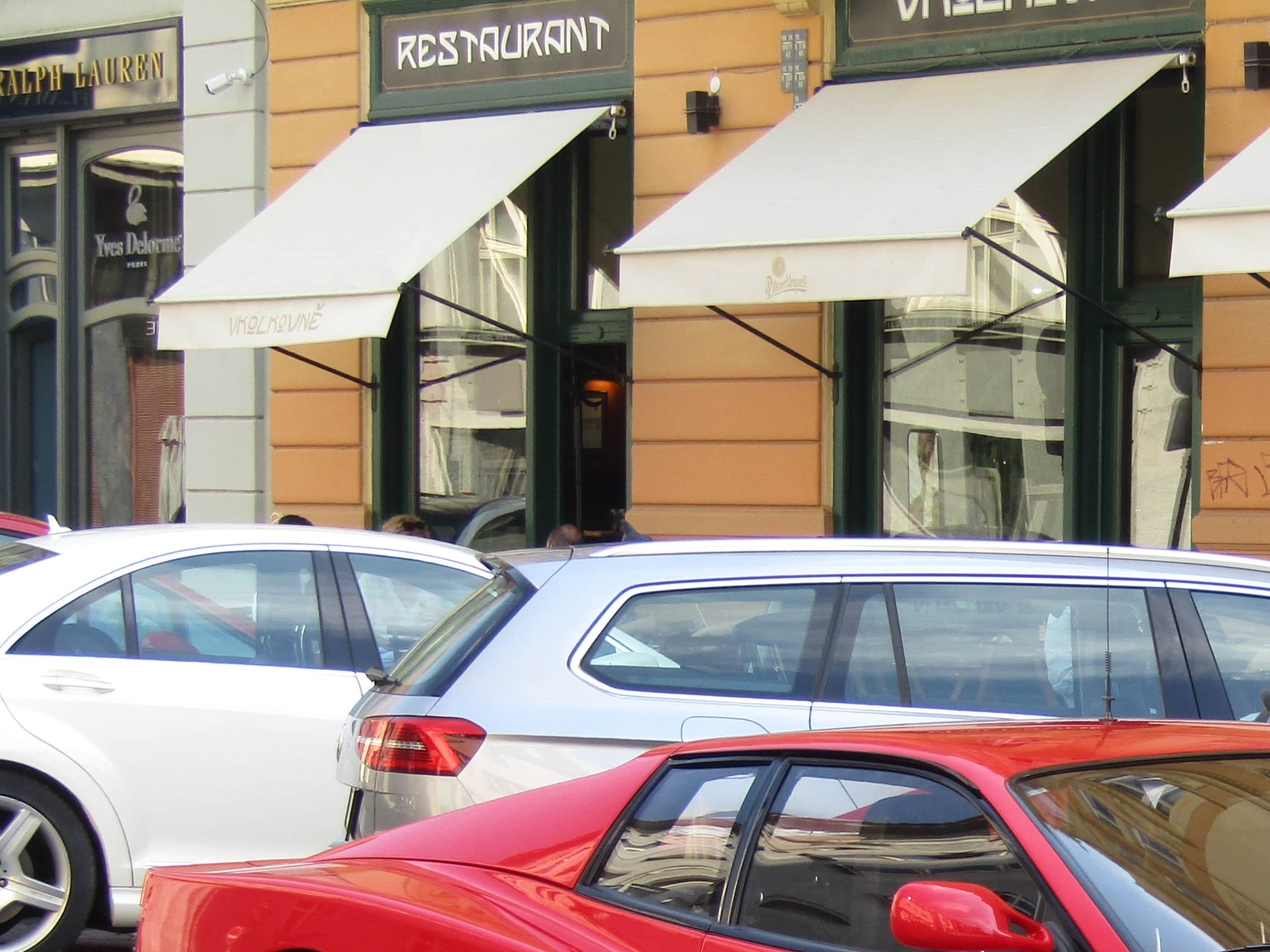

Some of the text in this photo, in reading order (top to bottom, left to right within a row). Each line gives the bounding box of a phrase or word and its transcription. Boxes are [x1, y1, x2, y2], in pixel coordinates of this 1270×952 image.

[397, 16, 610, 70] RESTAURANT
[74, 52, 165, 89] LAUREN
[94, 233, 124, 257] Yves
[229, 303, 326, 336] VKOLKOVNĚ
